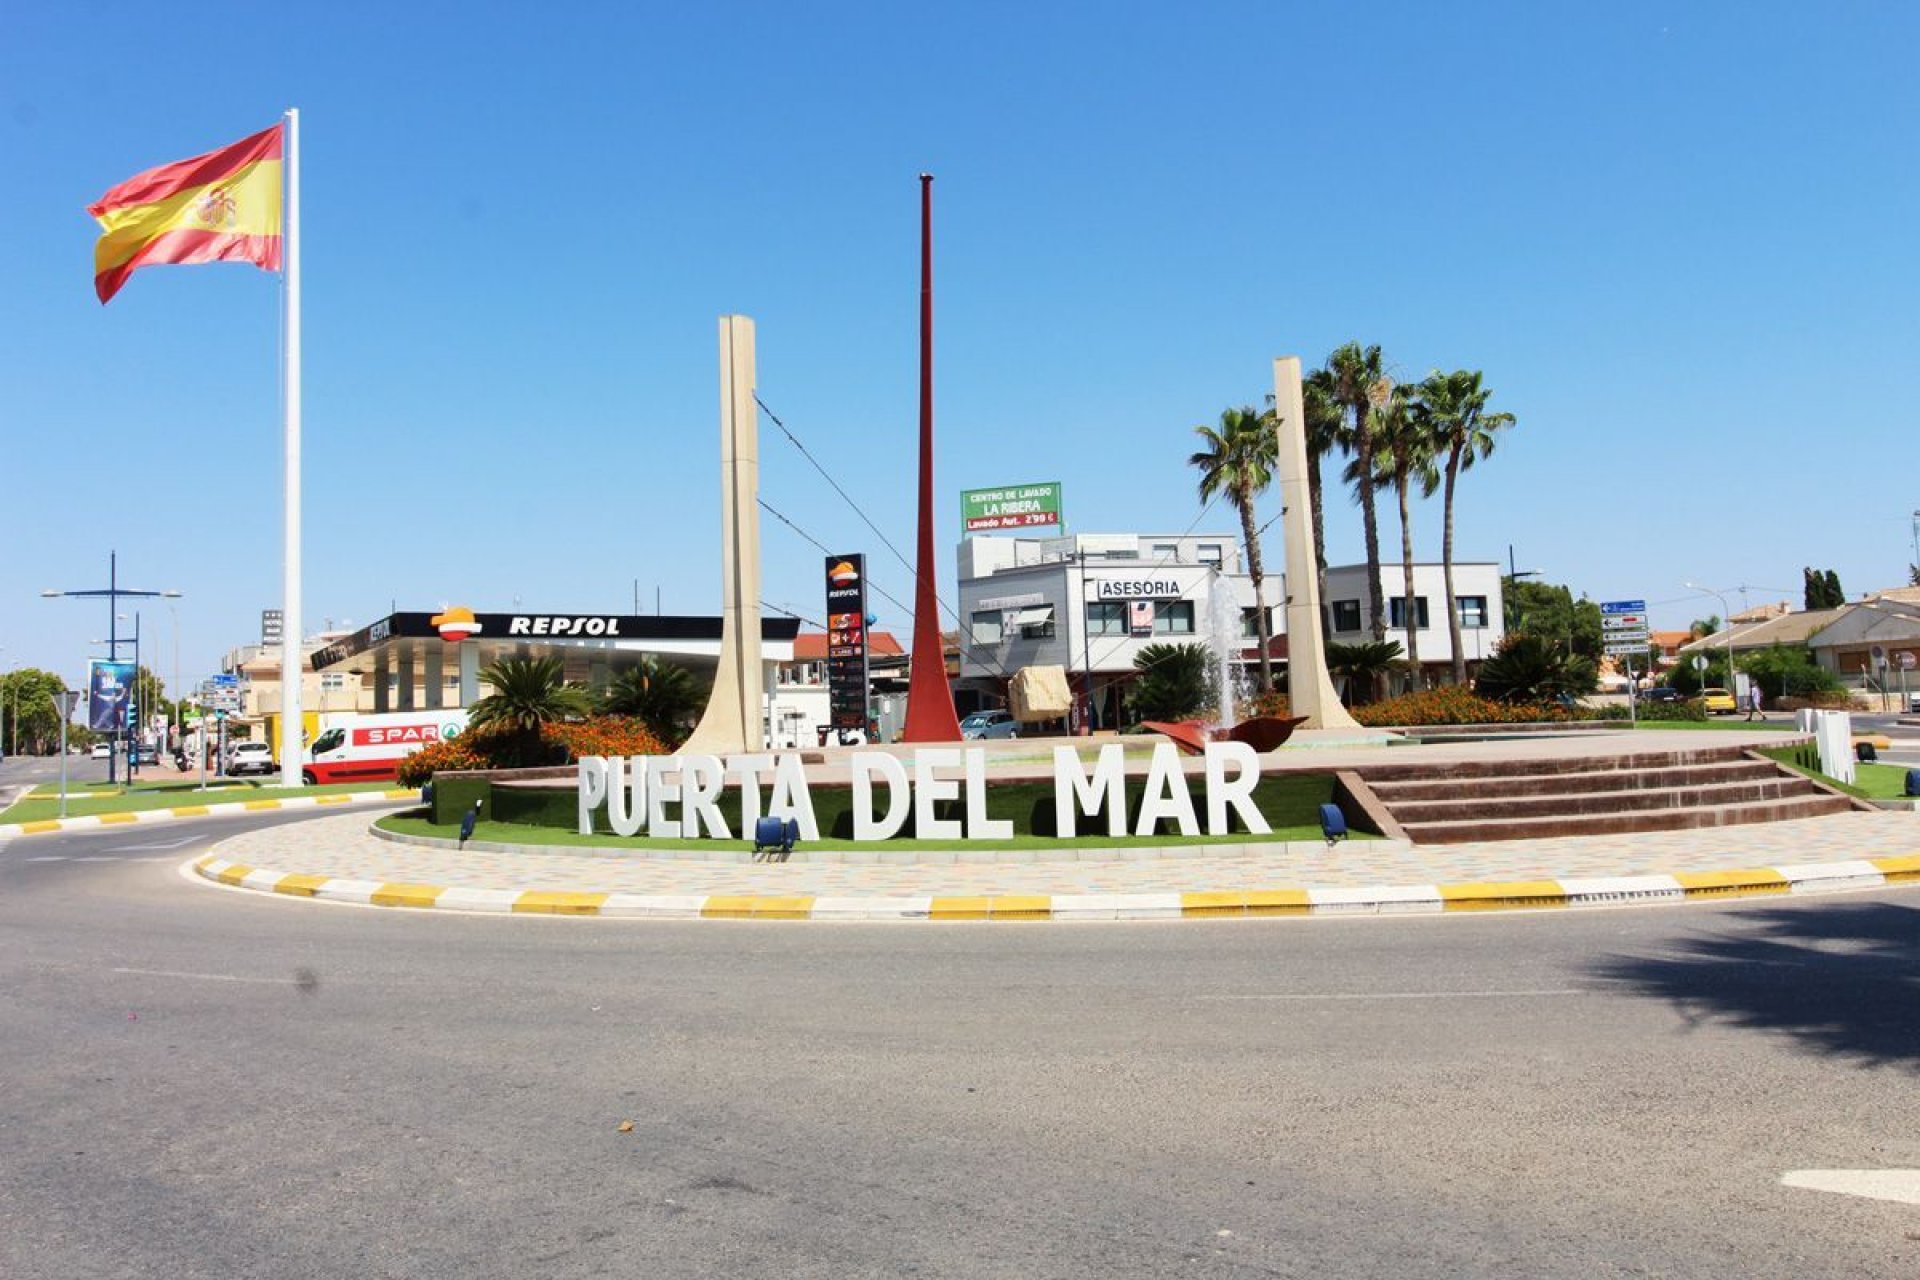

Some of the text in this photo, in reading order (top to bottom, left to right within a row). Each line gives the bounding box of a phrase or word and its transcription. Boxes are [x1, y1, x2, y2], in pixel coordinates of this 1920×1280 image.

[970, 487, 1052, 503] CENTRO DE LAVADO
[983, 500, 1041, 516] LA RIBERA
[967, 518, 999, 529] Lavado
[829, 588, 859, 598] REPSOL
[1102, 581, 1180, 596] ASESORIA
[509, 616, 620, 635] REPSOL
[368, 727, 438, 743] SPAR
[578, 741, 1273, 841] PUERTA DEL MAR
